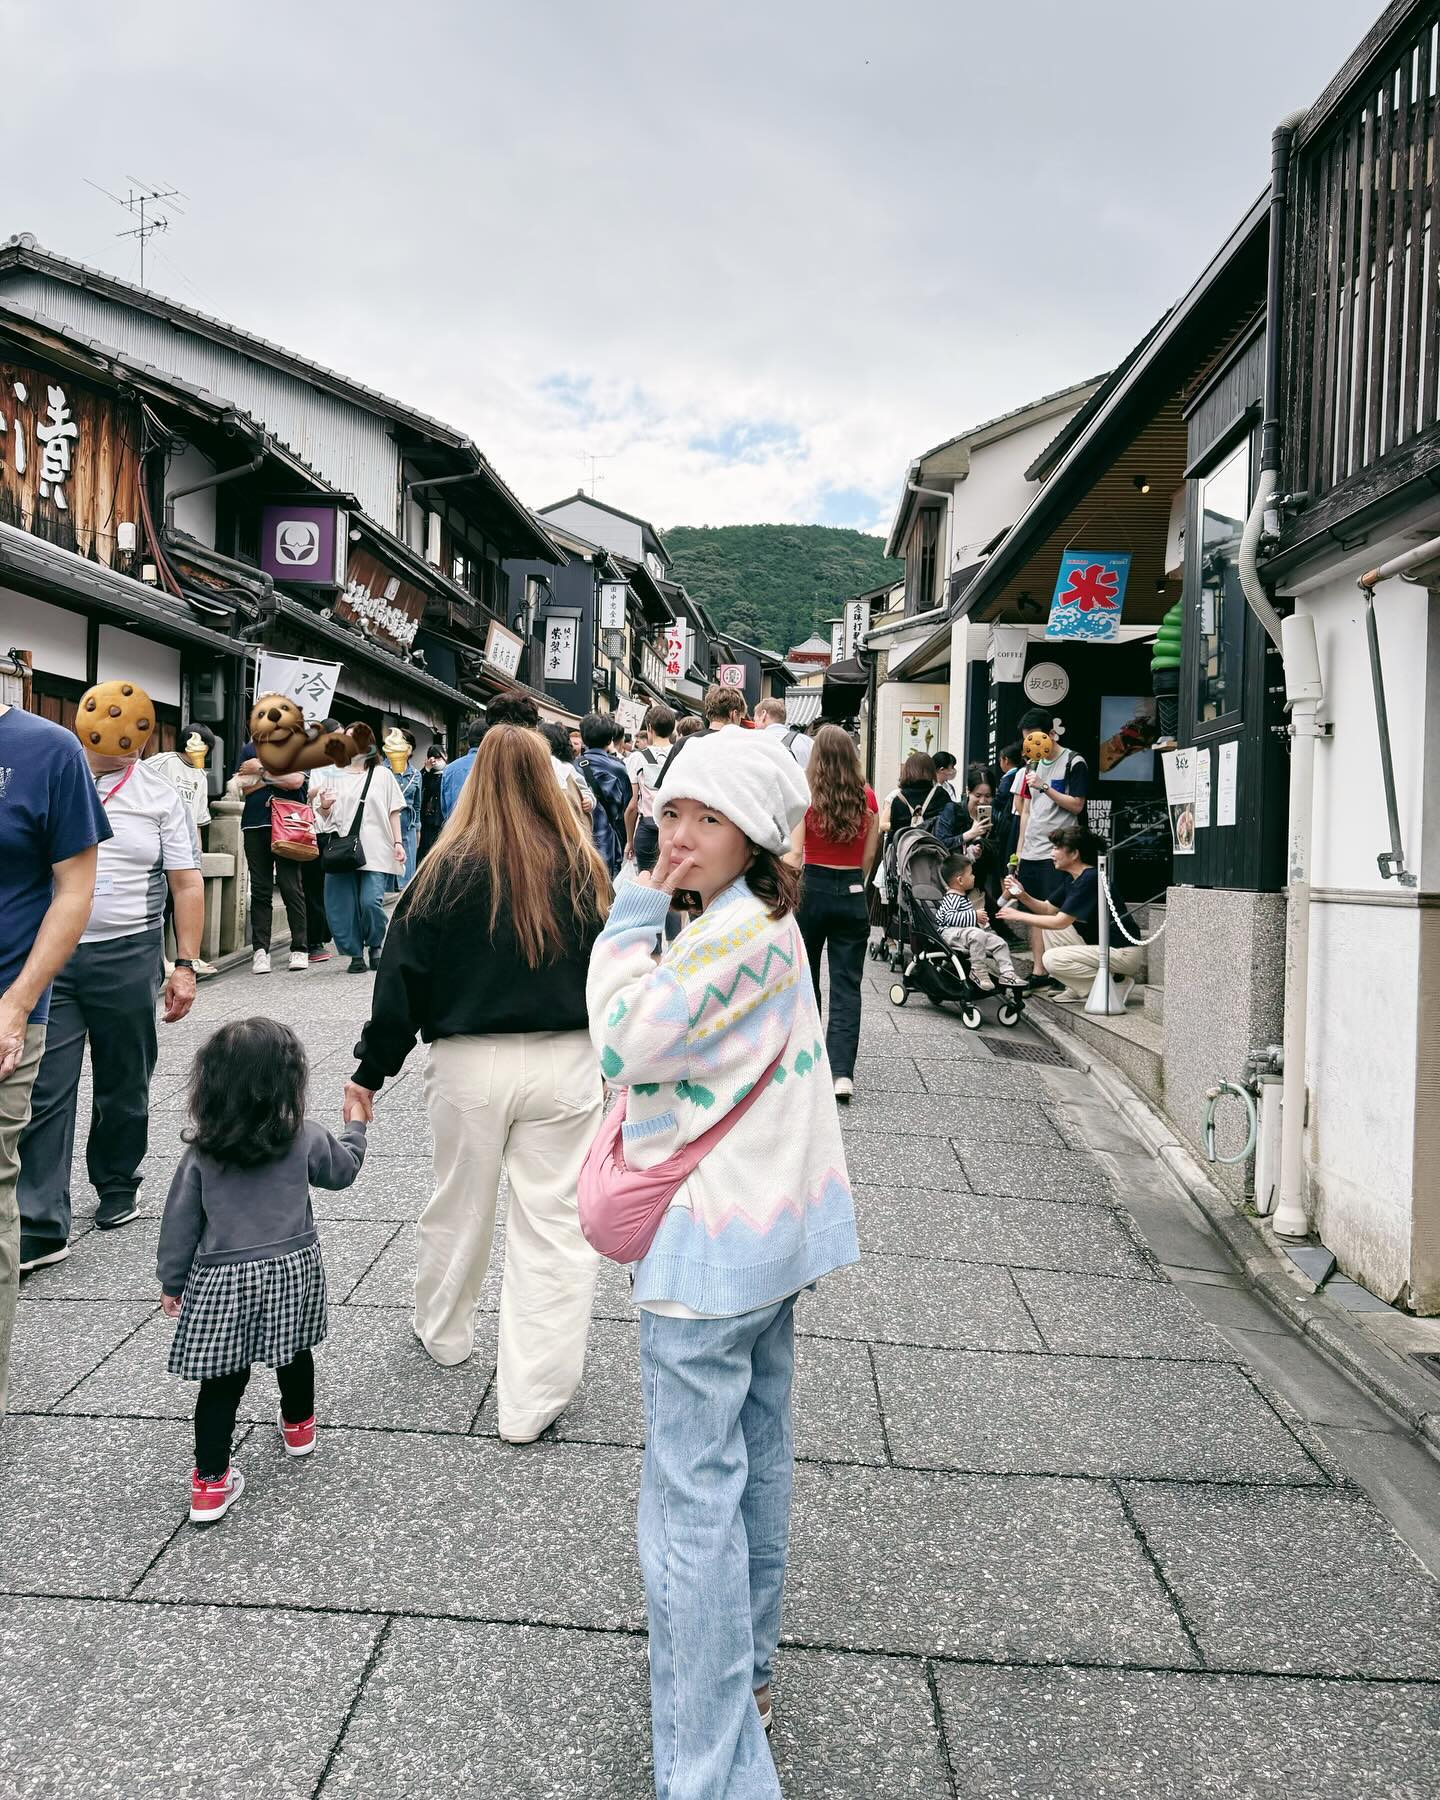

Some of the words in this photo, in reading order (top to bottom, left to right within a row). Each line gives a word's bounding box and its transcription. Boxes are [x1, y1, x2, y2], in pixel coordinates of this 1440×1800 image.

[1058, 563, 1121, 613] 氷
[294, 671, 331, 717] 冷
[1028, 677, 1065, 691] 坂の駅
[1098, 819, 1111, 829] ON
